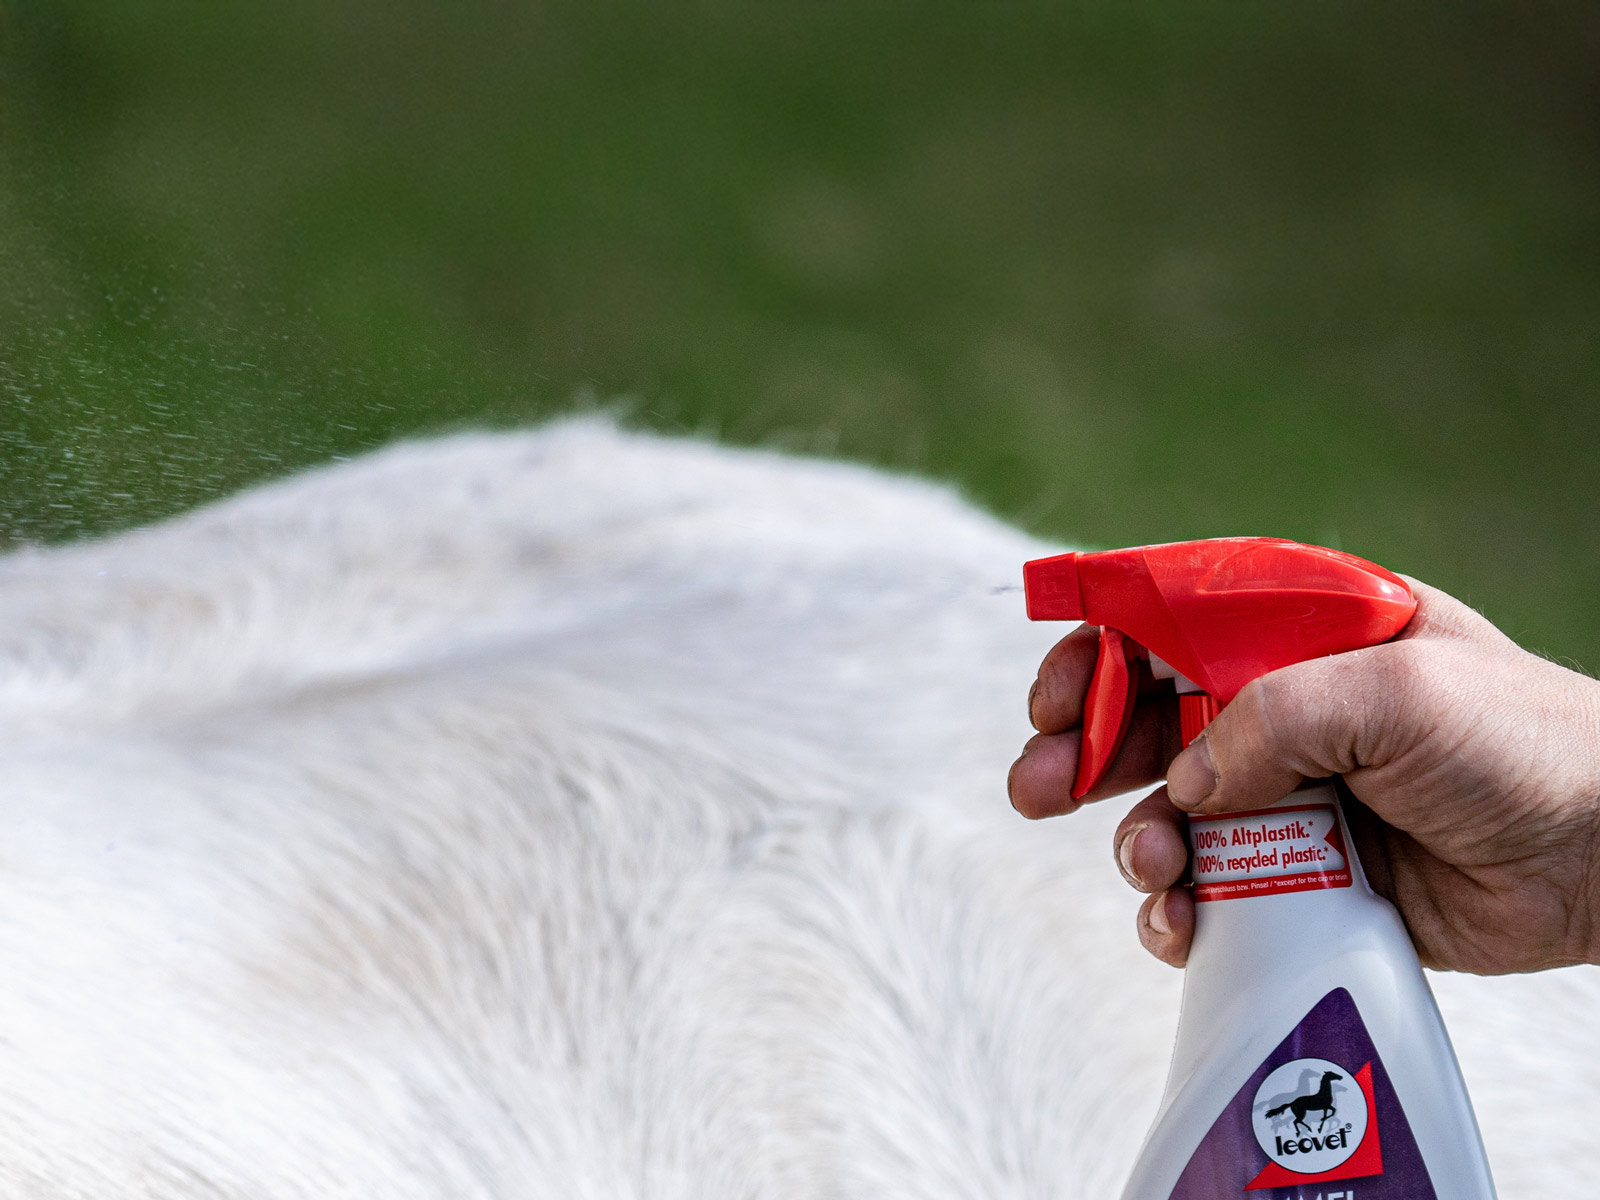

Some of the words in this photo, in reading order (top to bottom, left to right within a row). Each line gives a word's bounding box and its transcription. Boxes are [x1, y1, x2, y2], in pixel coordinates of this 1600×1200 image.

[1195, 830, 1227, 849] 100%
[1197, 854, 1225, 873] 100%
[1227, 848, 1278, 873] recycled
